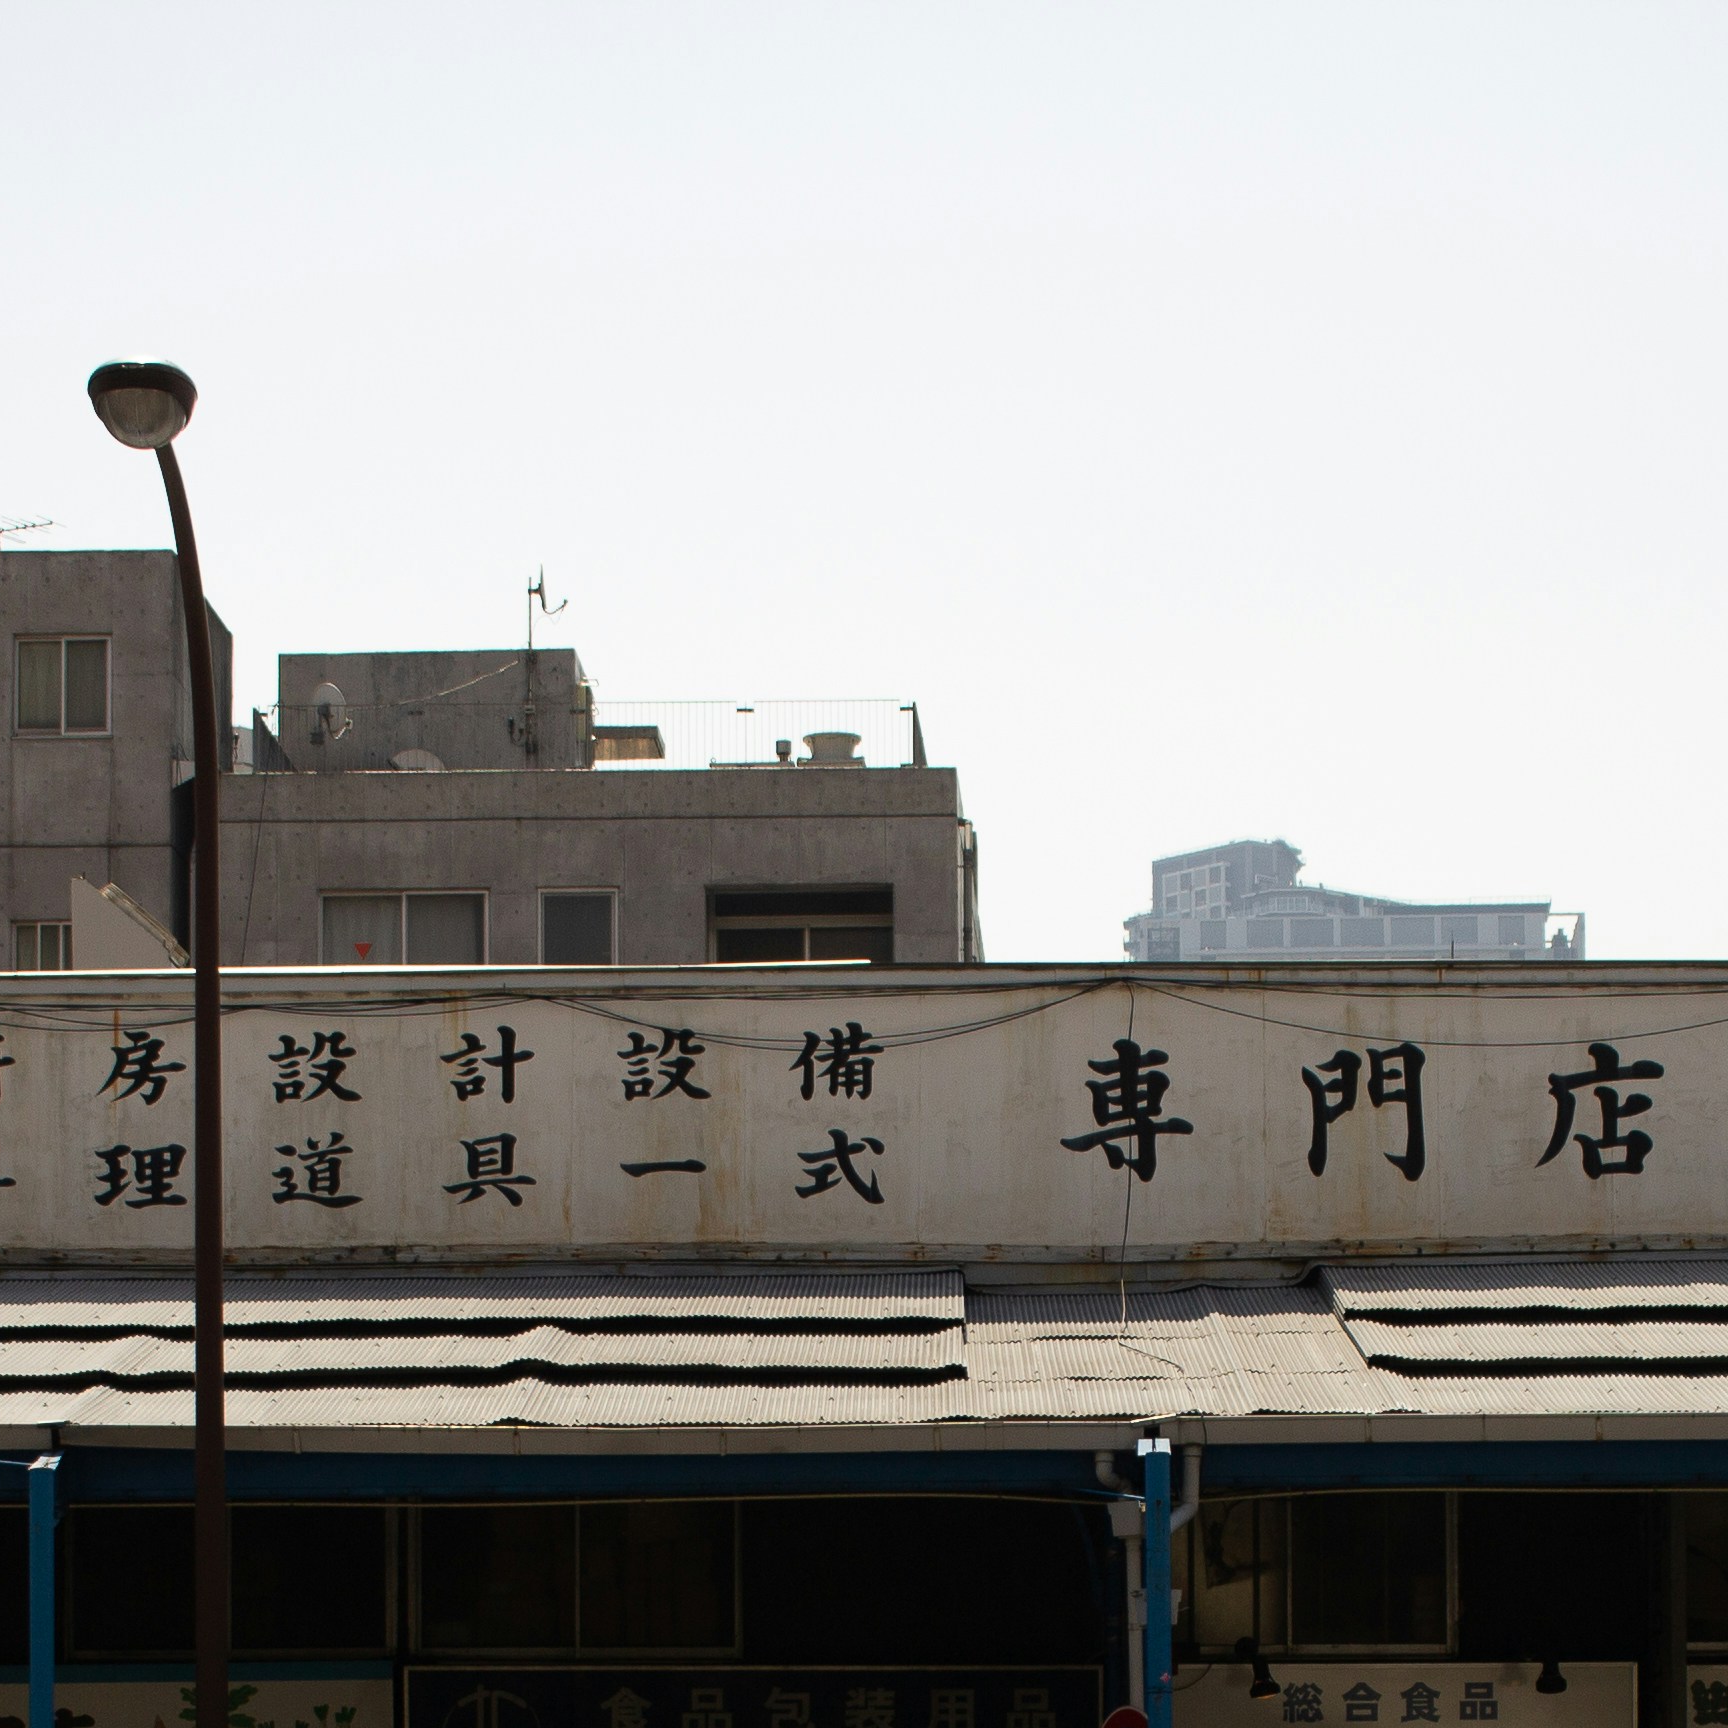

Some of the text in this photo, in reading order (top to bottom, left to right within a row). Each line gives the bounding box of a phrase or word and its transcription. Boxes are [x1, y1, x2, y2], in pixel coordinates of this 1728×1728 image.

[1060, 1038, 1664, 1183] 専門店
[1282, 1681, 1499, 1724] 総合食品
